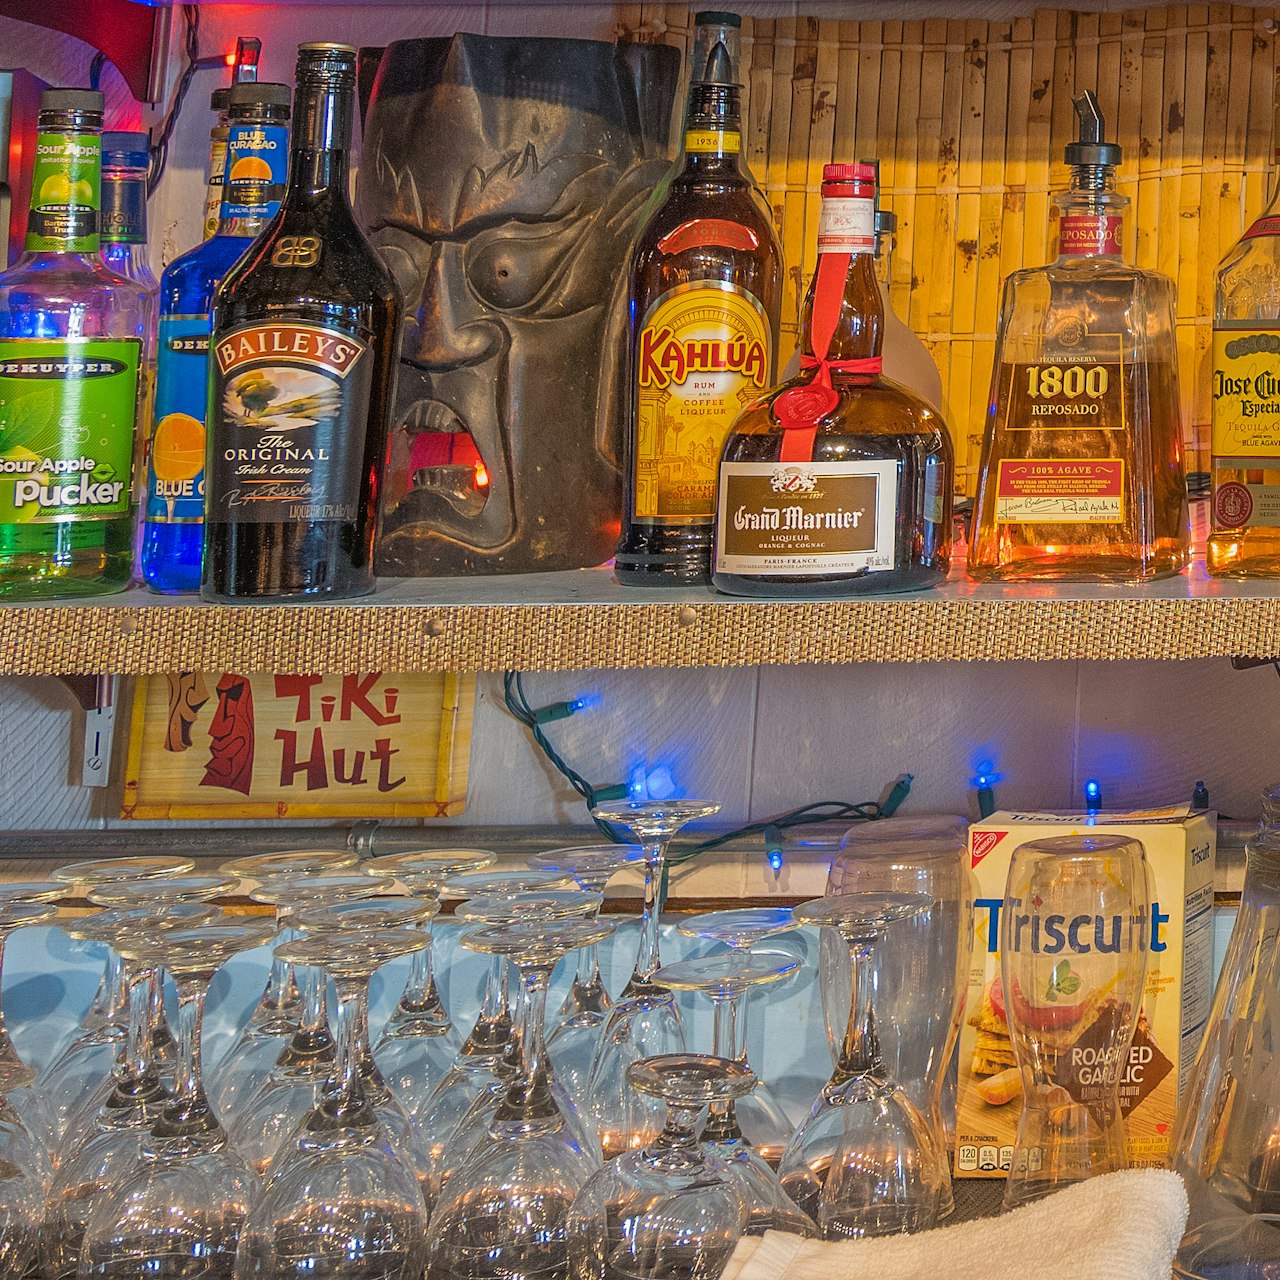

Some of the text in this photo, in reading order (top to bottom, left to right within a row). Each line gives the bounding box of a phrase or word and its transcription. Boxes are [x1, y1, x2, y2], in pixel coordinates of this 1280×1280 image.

[237, 131, 266, 141] BLUE
[37, 143, 100, 158] Sour Apple
[221, 334, 350, 365] BAILEYS
[641, 328, 766, 387] KAHLÚA
[1026, 364, 1108, 399] 1800
[1213, 370, 1251, 400] Jose
[683, 399, 724, 407] COFFEE
[1031, 404, 1099, 416] REPOSADO
[680, 408, 727, 416] LIQUEUR
[1226, 422, 1269, 433] TEQUILA
[257, 435, 294, 449] The
[224, 448, 330, 462] ORIGINAL
[39, 456, 95, 476] Apple
[235, 464, 313, 476] Irish Cream
[1058, 466, 1092, 475] AGAVE
[155, 480, 195, 497] BLUE
[733, 504, 861, 532] Grand Marnier
[771, 534, 810, 542] LIQUEUR
[275, 727, 406, 793] Hut
[974, 834, 996, 856] NABISCO
[1191, 842, 1210, 866] Triscuit
[974, 898, 1170, 954] Triscuit
[961, 1148, 976, 1159] 120
